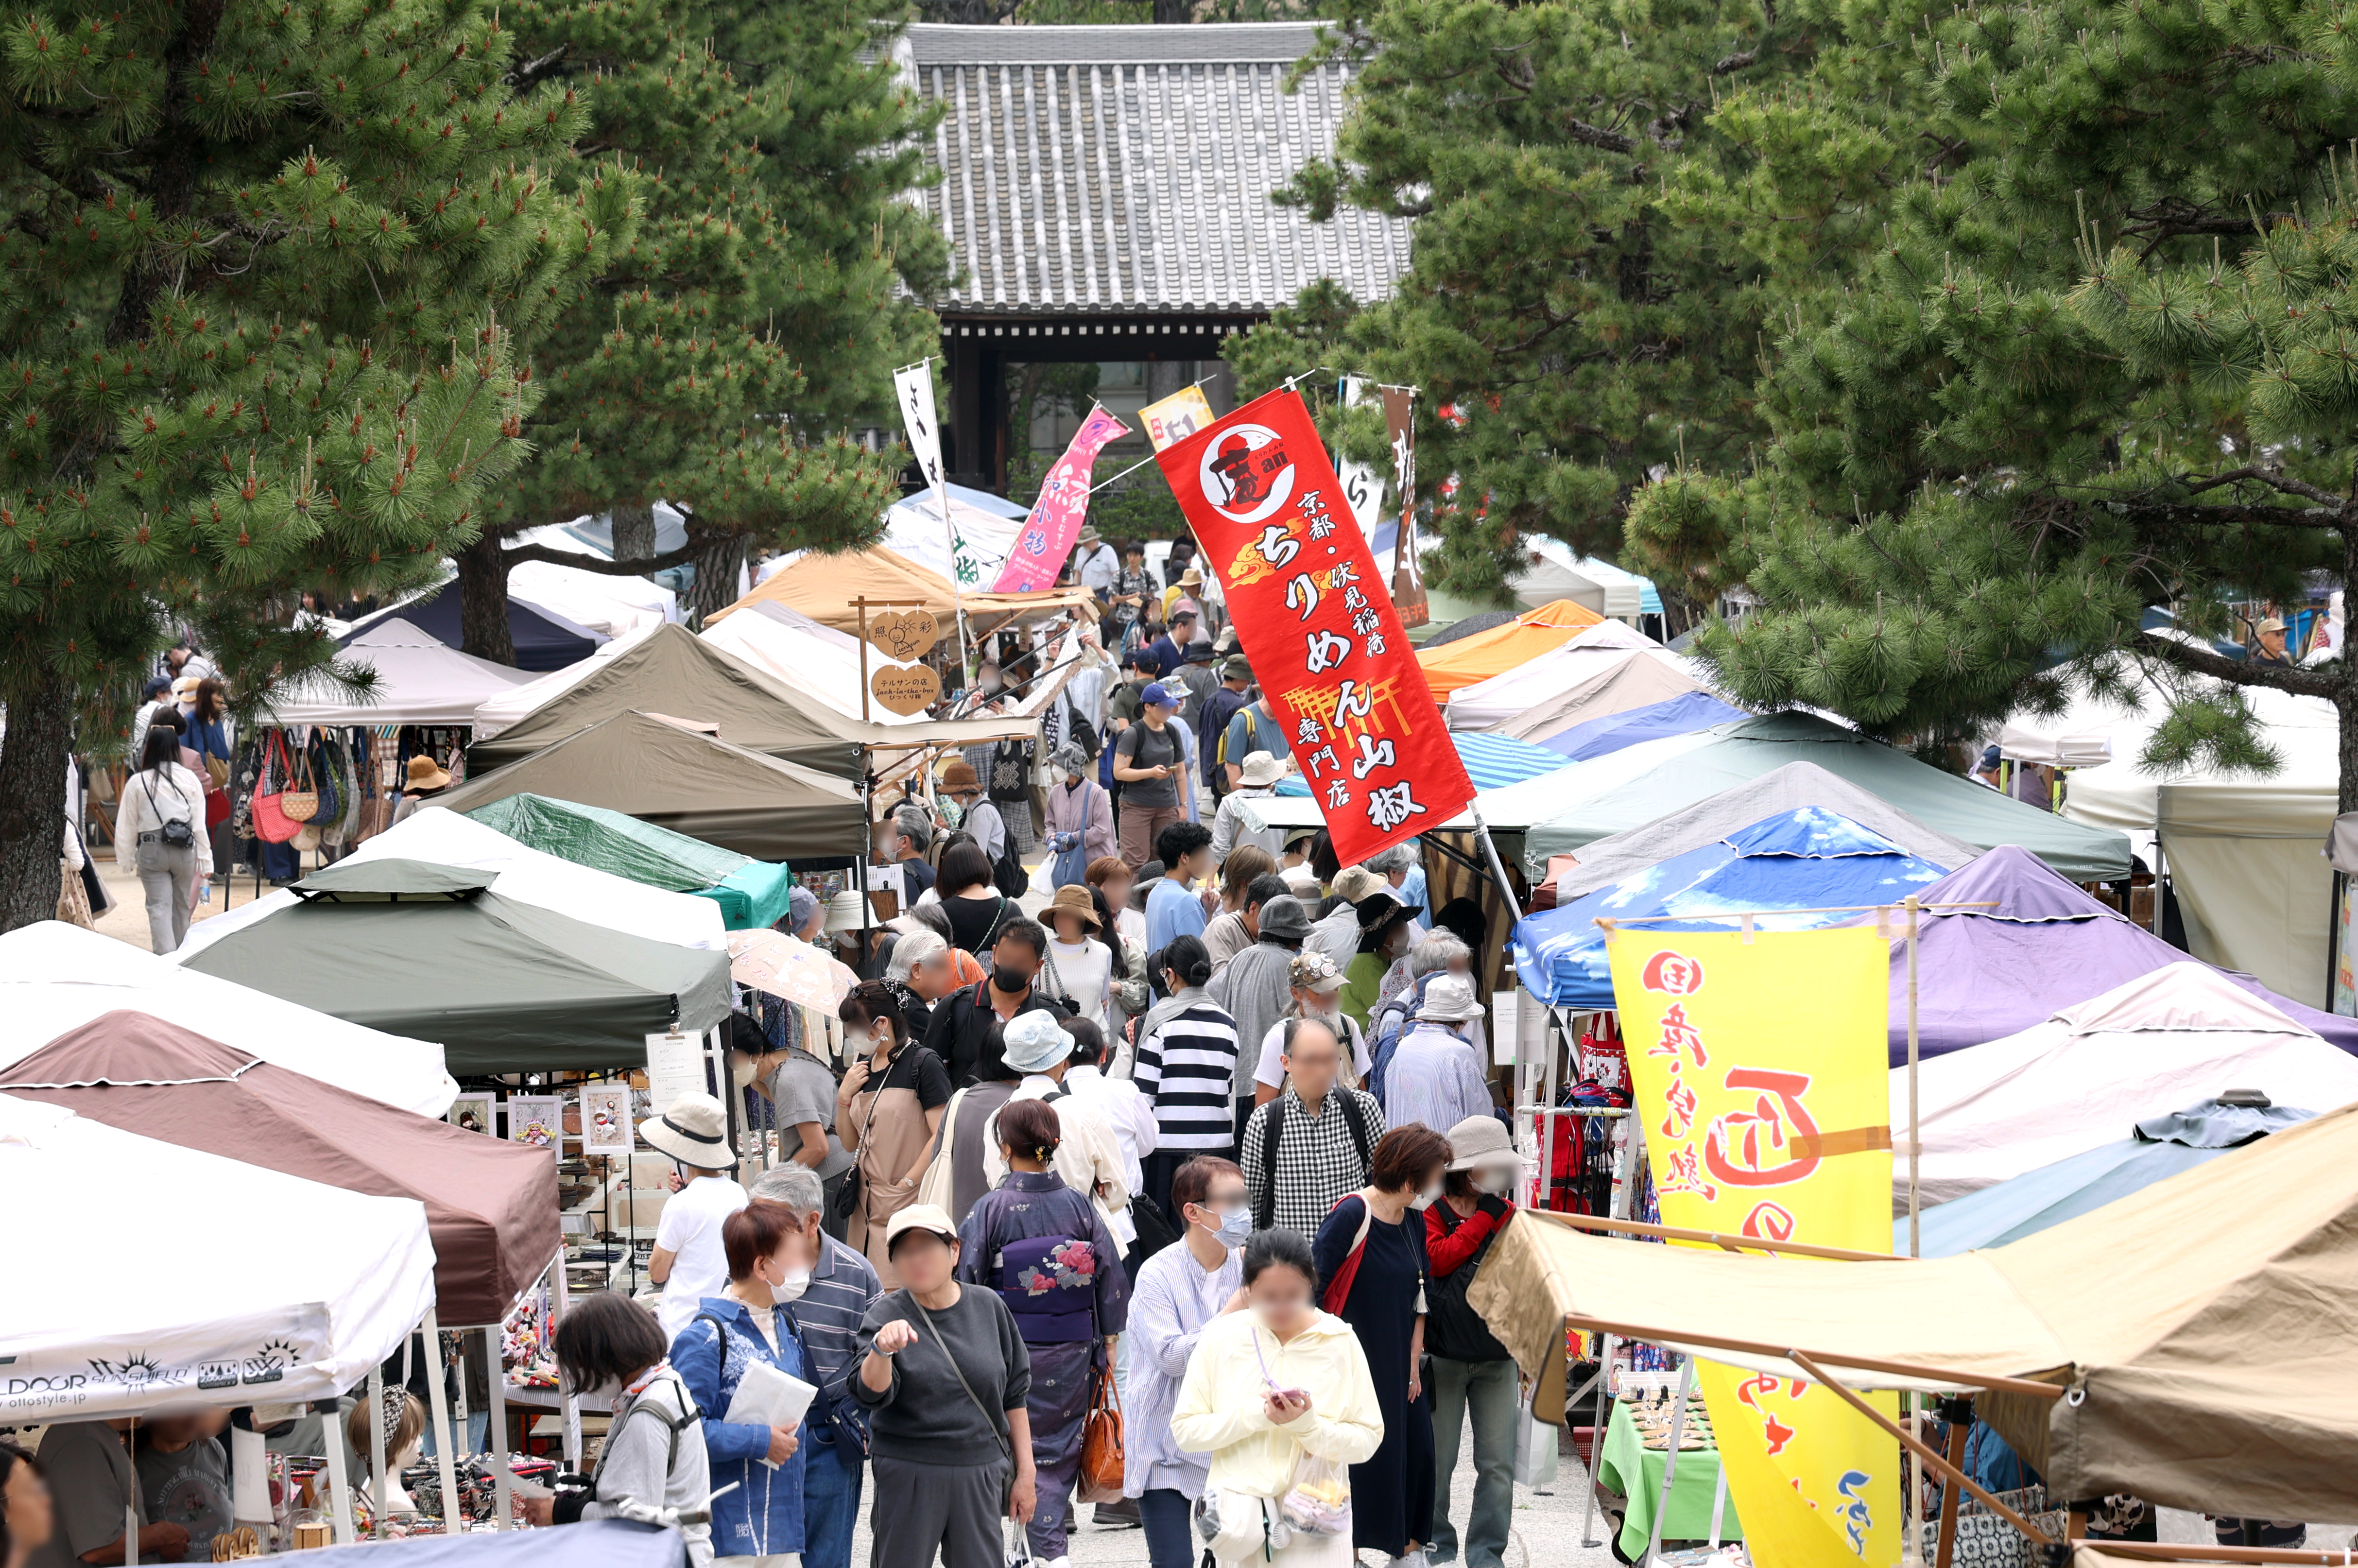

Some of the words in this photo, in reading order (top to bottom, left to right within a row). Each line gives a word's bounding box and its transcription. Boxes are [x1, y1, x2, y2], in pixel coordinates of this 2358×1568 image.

[1261, 450, 1289, 474] an
[1296, 490, 1386, 658] 京都・伏見稲荷
[875, 626, 887, 638] 照
[919, 620, 932, 634] 彩
[881, 678, 928, 687] テルサンの店
[1256, 525, 1427, 832] ちりめん山椒
[876, 688, 934, 696] jack-in-the-box
[1297, 718, 1351, 810] 専門店
[91, 1373, 128, 1383] SUN
[127, 1368, 188, 1384] SHIELD
[9, 1392, 86, 1408] ottostyle.jp
[157, 1475, 180, 1506] NOTTING
[178, 1469, 192, 1480] HILL
